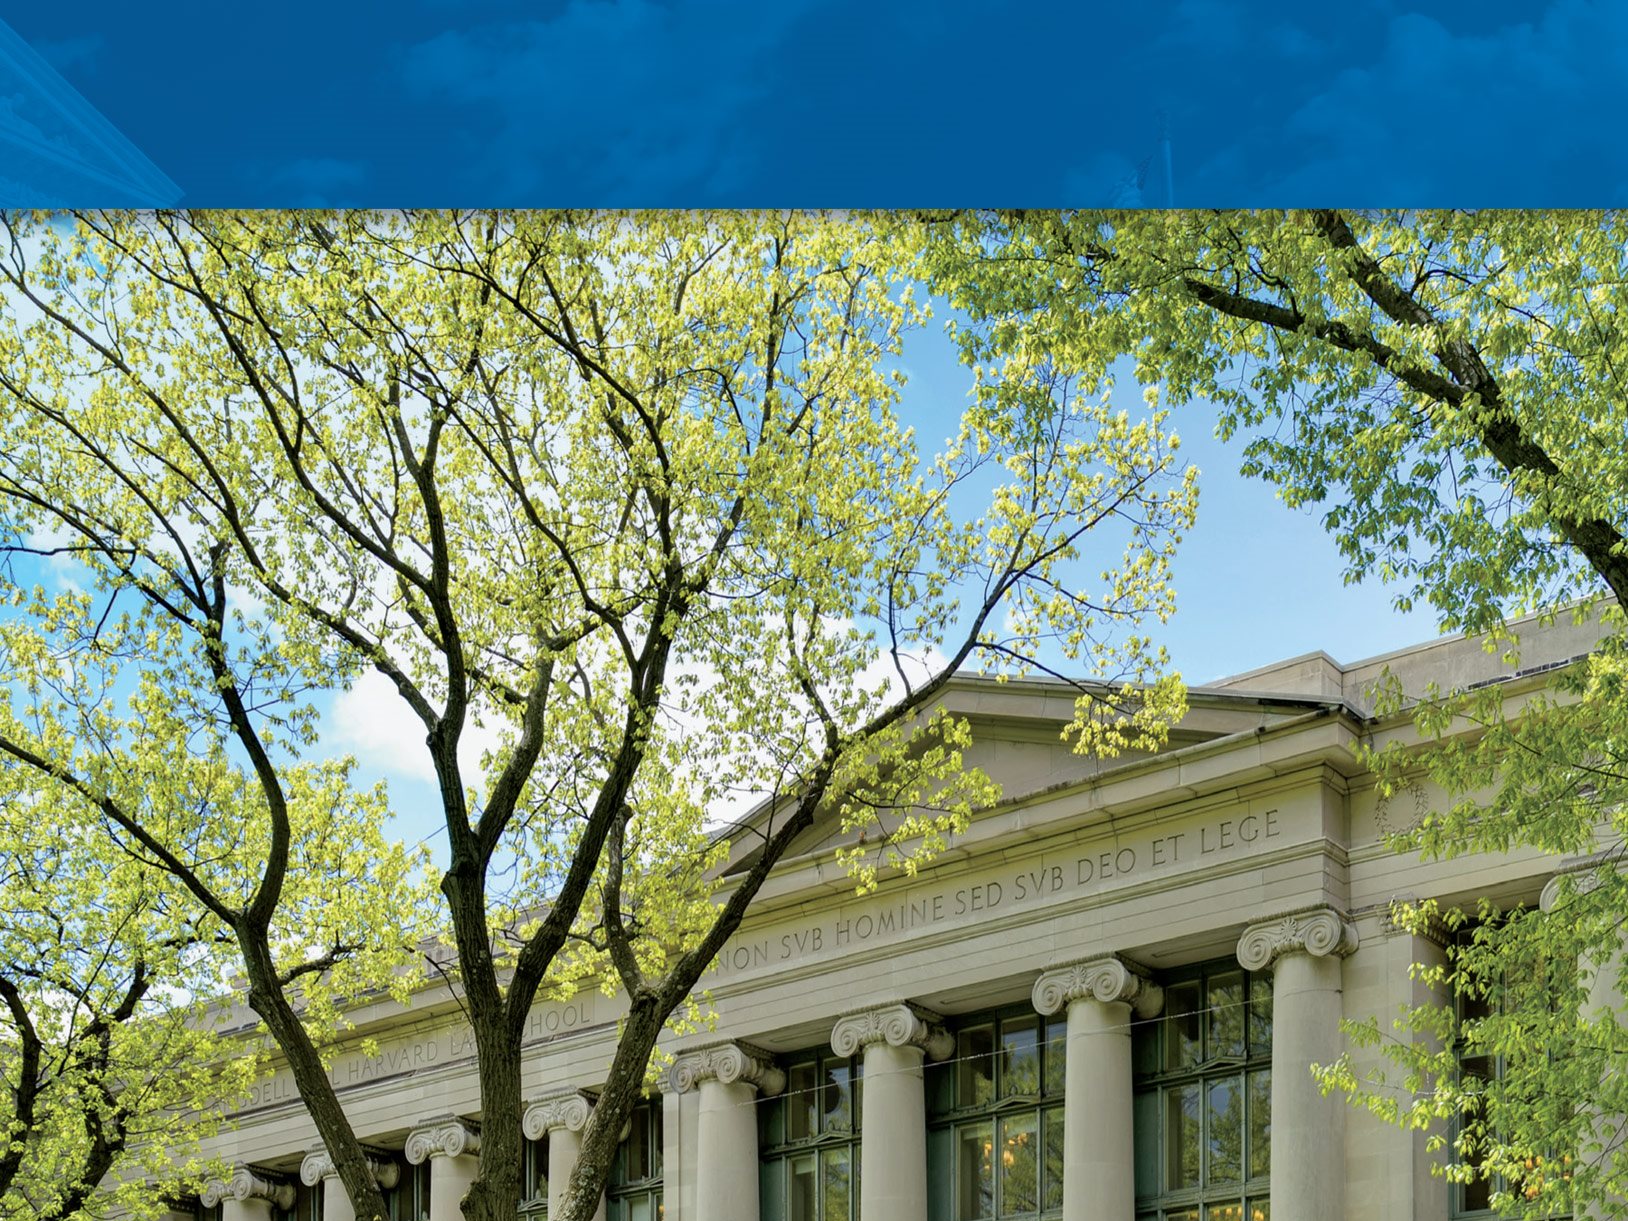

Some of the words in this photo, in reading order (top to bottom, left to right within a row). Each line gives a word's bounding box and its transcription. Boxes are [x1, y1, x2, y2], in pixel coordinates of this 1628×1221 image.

[715, 940, 769, 976] NON
[780, 927, 824, 960] SVB
[835, 894, 945, 947] HOMINE
[954, 881, 1003, 916] SED
[1014, 865, 1065, 901] SVB
[1077, 847, 1137, 886] DEO
[1151, 833, 1186, 867] ET
[1200, 808, 1281, 855] LEGE
[348, 1040, 438, 1082] HARVARD
